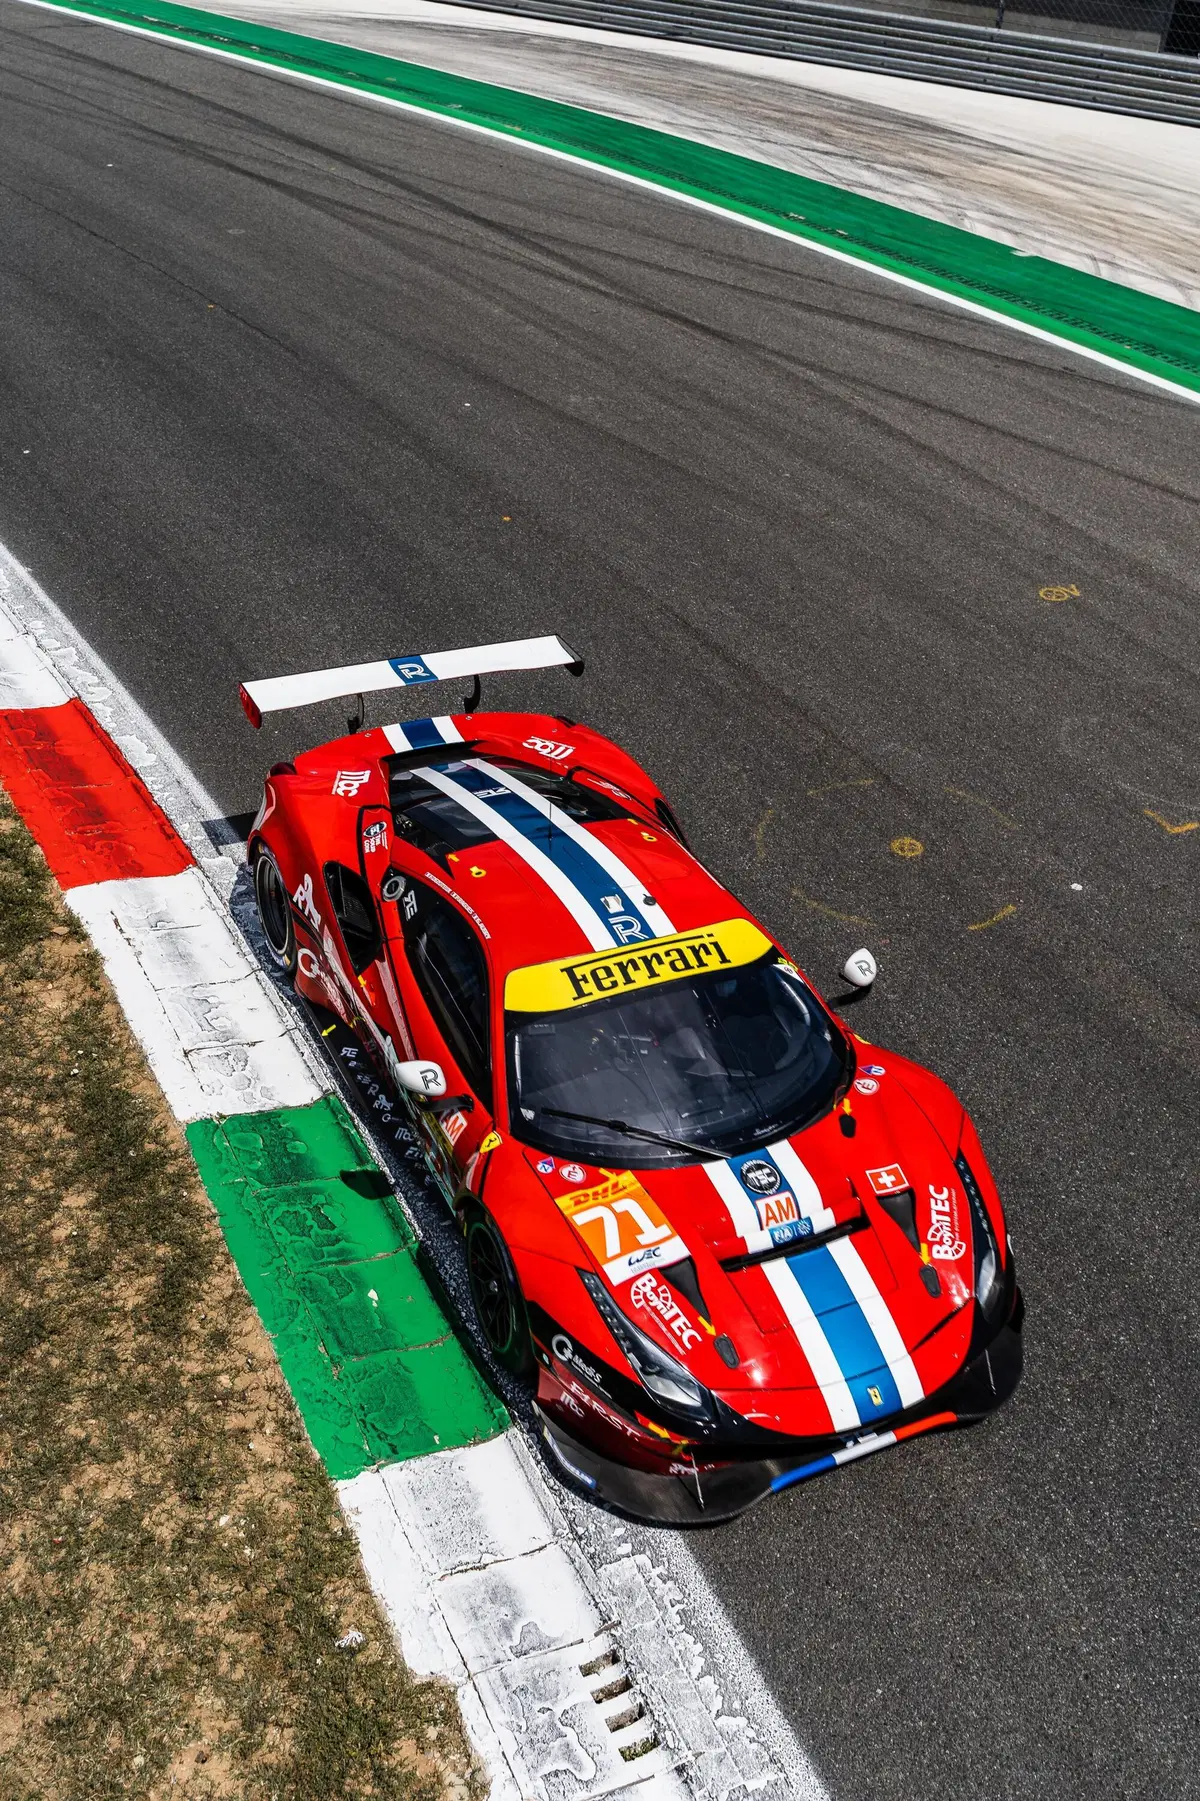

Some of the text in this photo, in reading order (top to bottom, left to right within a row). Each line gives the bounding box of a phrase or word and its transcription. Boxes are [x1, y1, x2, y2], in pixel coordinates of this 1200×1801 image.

[608, 915, 650, 944] R
[560, 933, 732, 1002] Ferrari
[419, 1068, 442, 1091] R
[570, 1181, 627, 1206] DHL
[765, 1196, 796, 1228] AM
[572, 1198, 673, 1259] 71
[773, 1226, 794, 1241] FIA
[628, 1247, 661, 1267] WEC
